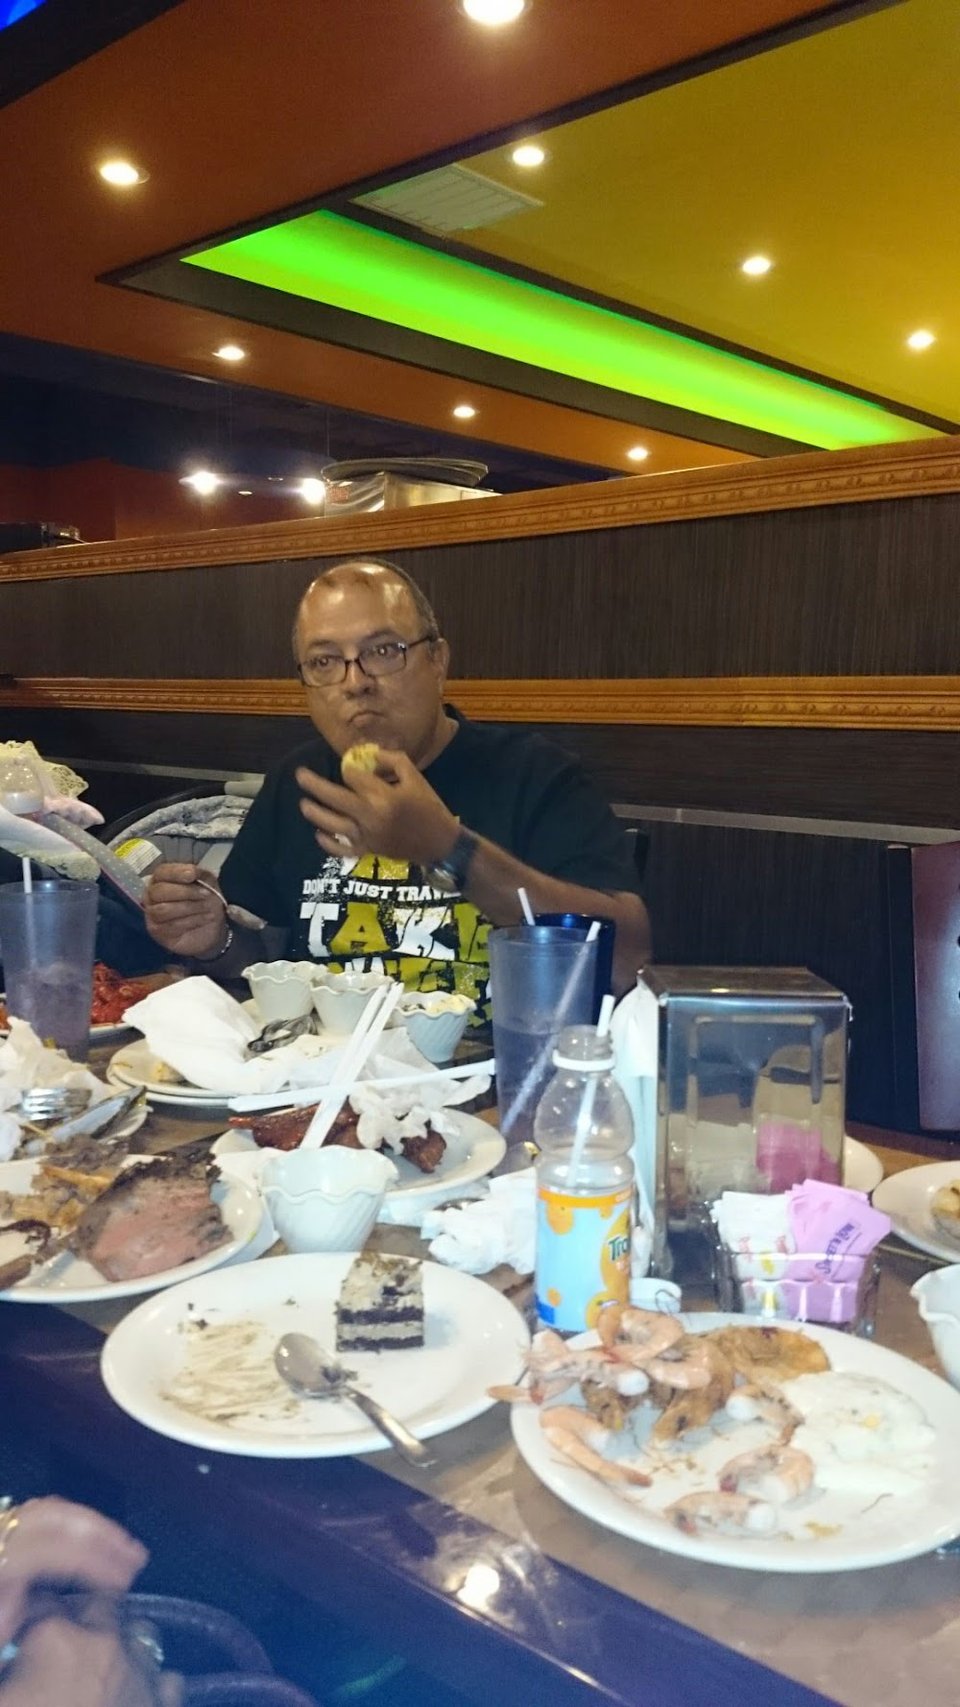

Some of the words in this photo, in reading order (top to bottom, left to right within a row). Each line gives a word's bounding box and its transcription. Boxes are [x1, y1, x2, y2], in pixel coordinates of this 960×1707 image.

[302, 878, 341, 895] DON'T
[343, 880, 393, 900] JUST
[300, 902, 491, 961] TAKE
